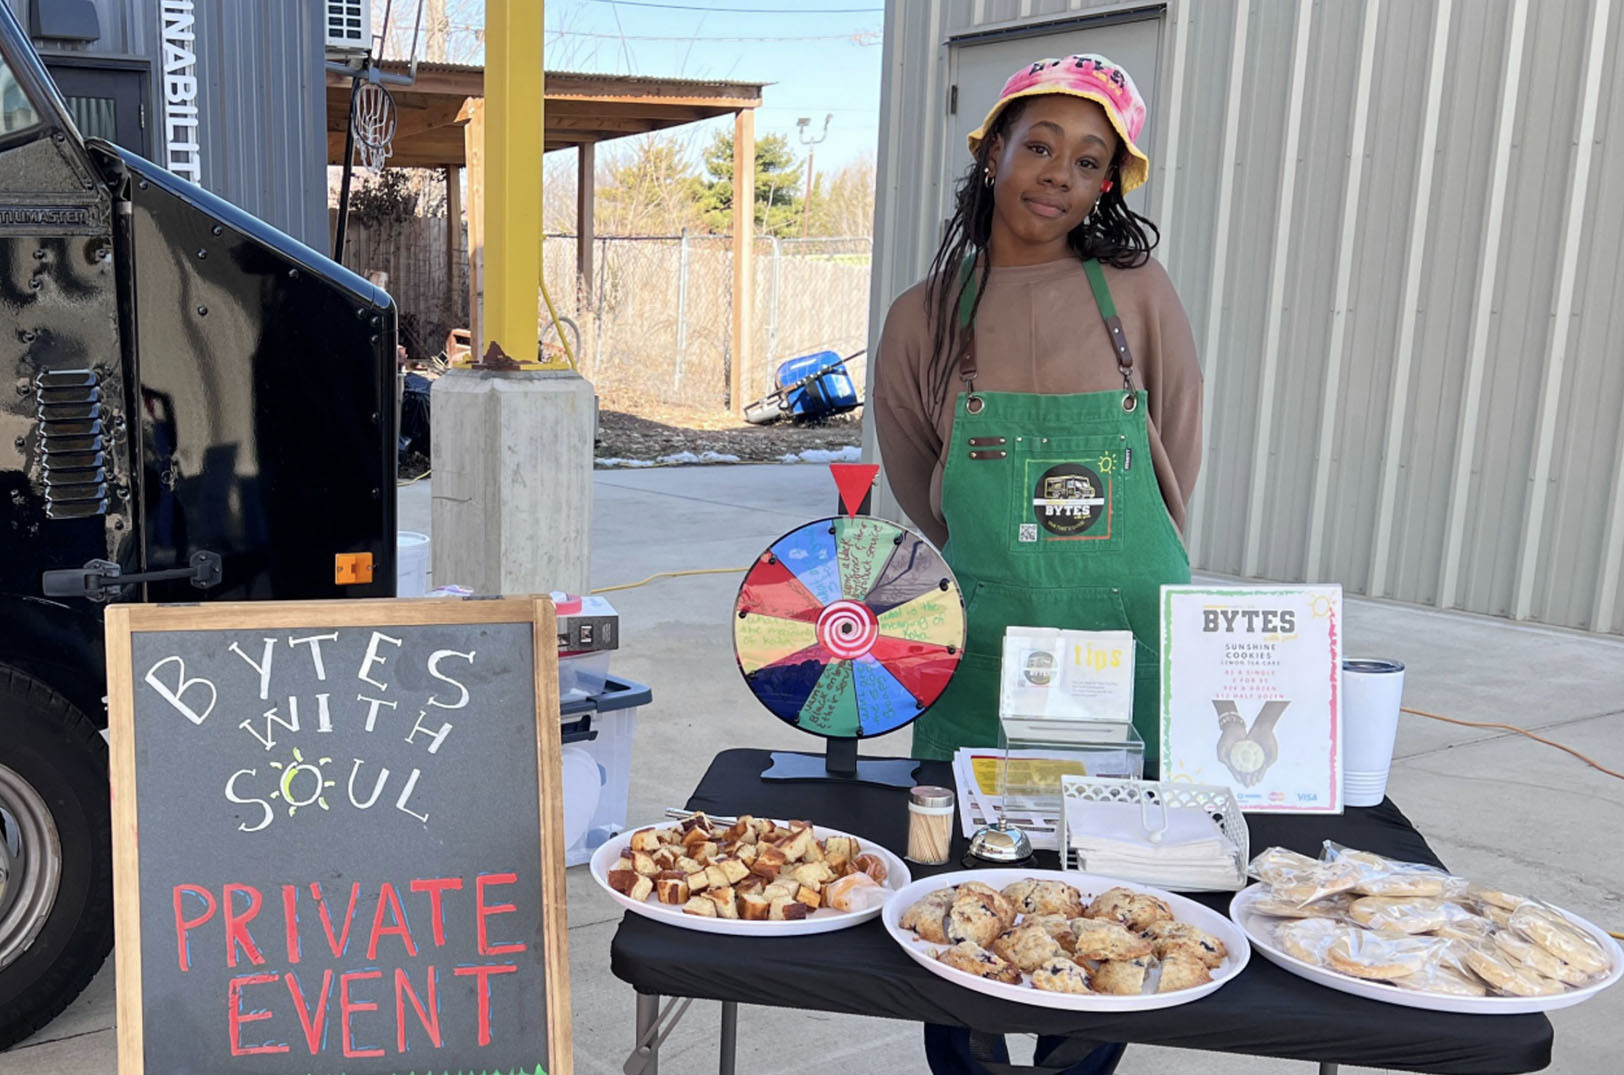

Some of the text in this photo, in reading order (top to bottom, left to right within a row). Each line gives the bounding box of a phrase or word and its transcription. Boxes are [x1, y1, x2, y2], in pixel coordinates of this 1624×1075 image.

[1045, 505, 1091, 516] BYTES
[1203, 610, 1296, 633] BYTES
[145, 631, 477, 725] BYTES
[1074, 640, 1123, 672] tips
[1225, 652, 1272, 660] COOKIES
[239, 693, 453, 754] WITH
[224, 752, 430, 832] SOUL
[1297, 792, 1318, 801] VISA
[173, 871, 528, 972] PRIVATE
[228, 960, 520, 1059] EVENT
